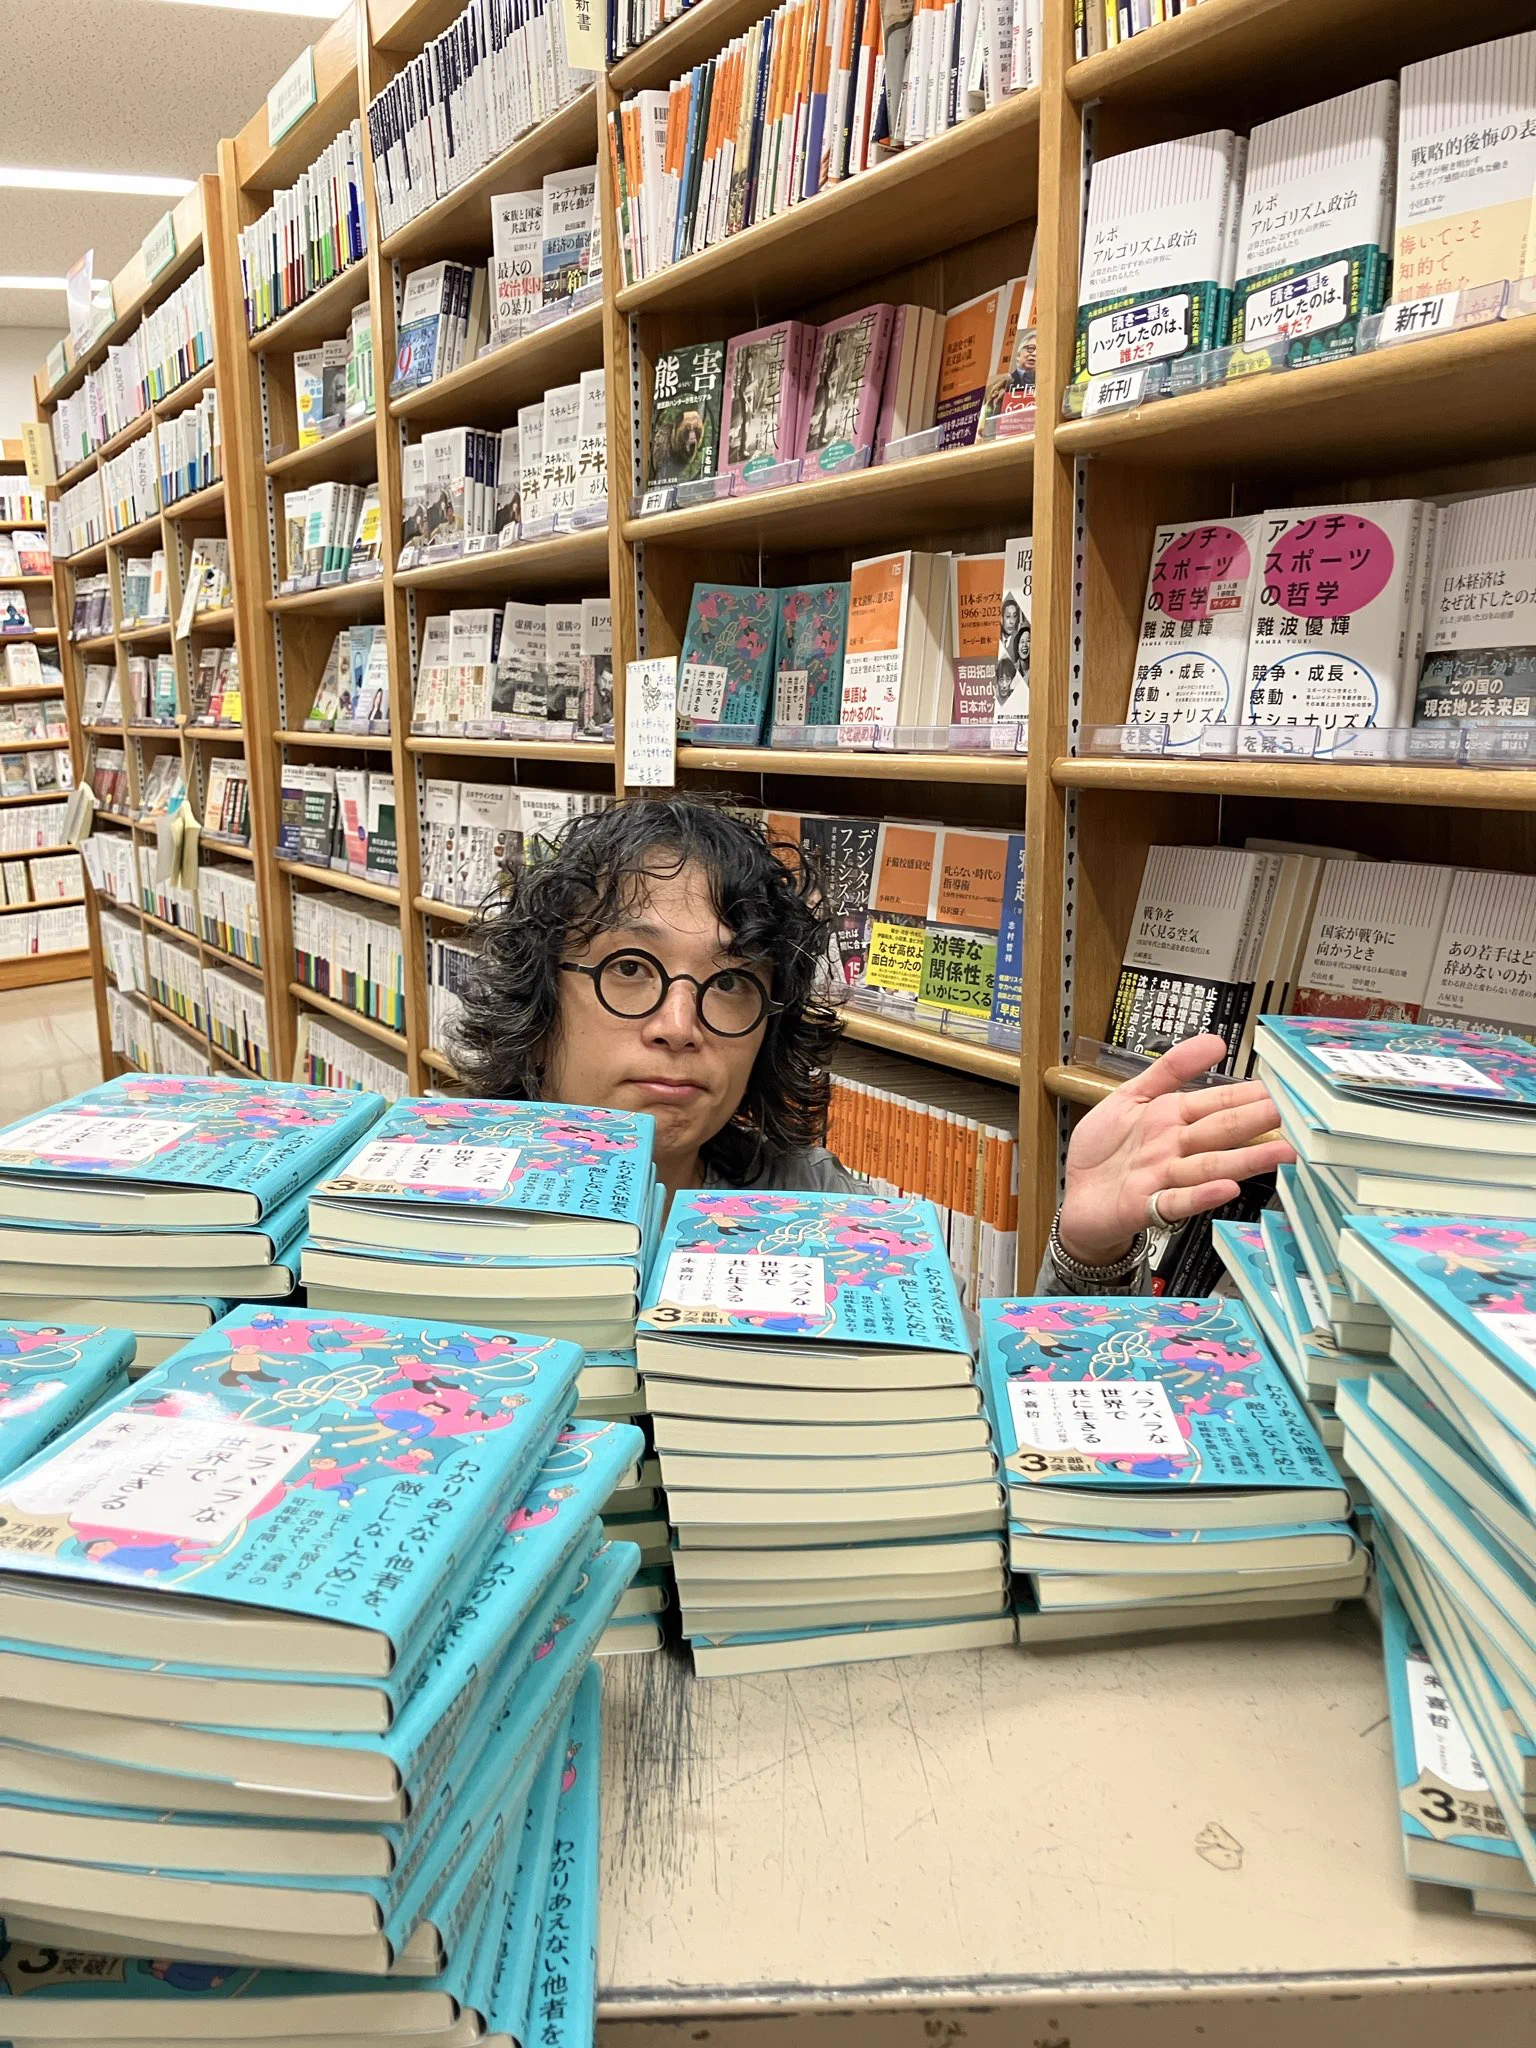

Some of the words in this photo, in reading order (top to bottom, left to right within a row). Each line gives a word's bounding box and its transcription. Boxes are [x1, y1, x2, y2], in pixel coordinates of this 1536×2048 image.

[502, 207, 544, 223] 家族と国家
[1250, 190, 1358, 237] アルゴリズム政治
[1251, 194, 1279, 217] ルポ
[512, 219, 541, 235] 共謀する
[1095, 226, 1119, 246] ルポ
[1399, 220, 1482, 256] 悔いてこそ
[1093, 229, 1198, 264] アルゴリズム政治
[498, 260, 532, 280] 最大の
[1397, 251, 1454, 282] 知的で
[1271, 273, 1330, 307] 清き一票を
[500, 297, 532, 317] の暴力
[1112, 303, 1171, 333] 清き一票を
[1250, 288, 1342, 331] ハックしたのは、
[1395, 298, 1443, 333] 新刊
[1093, 319, 1183, 353] ハックしたのは、
[1119, 342, 1155, 364] 誰だ?
[654, 348, 724, 401] 熊害
[764, 328, 788, 450] 宇野千代
[1098, 377, 1132, 405] 新刊
[543, 464, 577, 489] デキル
[1157, 526, 1233, 553] アンチ・
[1267, 516, 1366, 543] アンチ・
[1152, 556, 1235, 582] スポーツ
[1263, 548, 1371, 575] スポーツ
[1260, 581, 1340, 608] の哲学
[1444, 571, 1507, 594] 日本経済は
[1148, 586, 1208, 612] の哲学
[1143, 617, 1214, 640] 難波優輝
[1256, 614, 1351, 638] 難波優輝
[704, 671, 716, 697] 世界で
[958, 665, 996, 679] 吉田拓郎
[1137, 663, 1217, 682] 競争・成長・
[1251, 664, 1360, 683] 競争・成長・
[692, 671, 707, 713] 共に生きる
[710, 672, 725, 715] バラバラな
[786, 677, 794, 721] 共に生きる
[797, 677, 807, 721] バラバラな
[844, 686, 868, 703] 単語は
[959, 682, 997, 699] Vaundy
[1134, 686, 1171, 703] 感動・
[1250, 688, 1298, 706] 感動・
[1450, 678, 1504, 696] この国の
[841, 706, 884, 722] わかるのに、
[1130, 708, 1228, 724] ナショナリズム
[1423, 696, 1531, 718] 現在地と未来図
[837, 828, 852, 917] ファシズム
[885, 856, 931, 872] 予備校盛衰史
[944, 864, 1002, 882] 叱らない時代の
[942, 877, 971, 891] 指導術
[1144, 906, 1174, 922] 戦争を
[1140, 921, 1201, 944] 甘く見る空気
[1320, 924, 1397, 945] 国家が戦争に
[932, 934, 984, 961] 対等な
[1317, 941, 1376, 962] 向かうとき
[1449, 941, 1535, 966] あの若手はど
[848, 961, 860, 978] 15
[871, 953, 922, 972] 面白かったの
[1444, 960, 1532, 985] 辞めないのか
[925, 982, 993, 1007] いかにつくる
[1151, 979, 1172, 1036] 中国敵視、
[1187, 985, 1206, 1029] 物価高、
[1134, 977, 1158, 1054] そしてメディアの
[1161, 981, 1183, 1037] 戦争準備、
[1171, 983, 1193, 1046] 軍備増強と
[327, 1180, 361, 1191] 3
[724, 1259, 750, 1303] 共に生きる
[759, 1260, 782, 1286] 世界で
[651, 1307, 682, 1323] 3
[684, 1310, 719, 1318] 万部
[898, 1279, 930, 1343] 敵にしないために。
[923, 1267, 961, 1347] わかりあえない他者を、
[1067, 1388, 1102, 1444] 共に生きる
[1099, 1388, 1129, 1421] 世界で
[1131, 1388, 1169, 1444] バラバラな
[1244, 1401, 1304, 1481] 敵にしないために。
[1263, 1382, 1335, 1484] わかりあえない他者を、
[185, 1434, 251, 1482] 世界で
[1019, 1453, 1049, 1472] 3
[1050, 1456, 1084, 1464] 万部
[1050, 1463, 1092, 1472] 突破!
[190, 1441, 298, 1525] バラバラな
[9, 1522, 58, 1538] 万部
[223, 1495, 304, 1582] 可能性を問いなおす
[359, 1459, 483, 1618] わかりあえない他者を、
[246, 1507, 319, 1588] 世の中で、「会話」の
[280, 1510, 355, 1591] 「正しさ」で殴りあう
[314, 1479, 428, 1608] 敵にしないために。
[1418, 1786, 1457, 1824] 3
[1458, 1799, 1504, 1821] 万部
[1461, 1814, 1510, 1838] 突破
[538, 1839, 576, 2046] わかりあえない他者を
